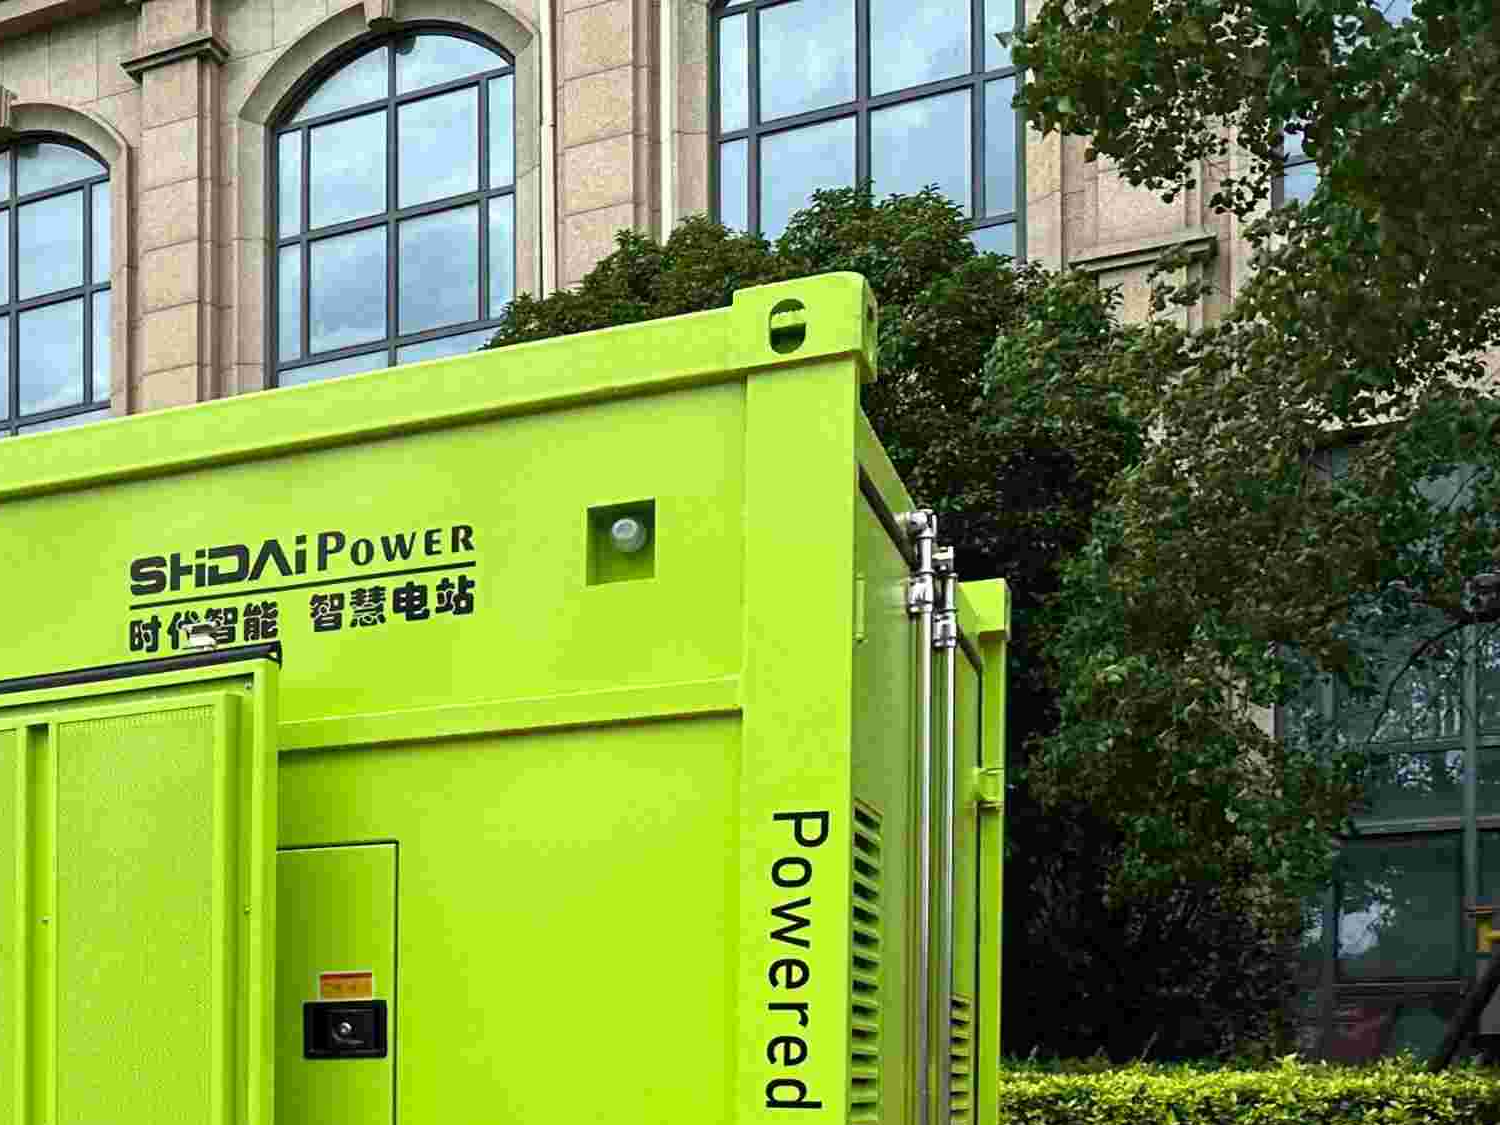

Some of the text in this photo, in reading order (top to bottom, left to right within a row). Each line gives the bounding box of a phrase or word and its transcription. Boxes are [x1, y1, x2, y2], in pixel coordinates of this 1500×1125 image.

[309, 574, 477, 633] 智慧电站
[765, 809, 831, 1110] Powered
